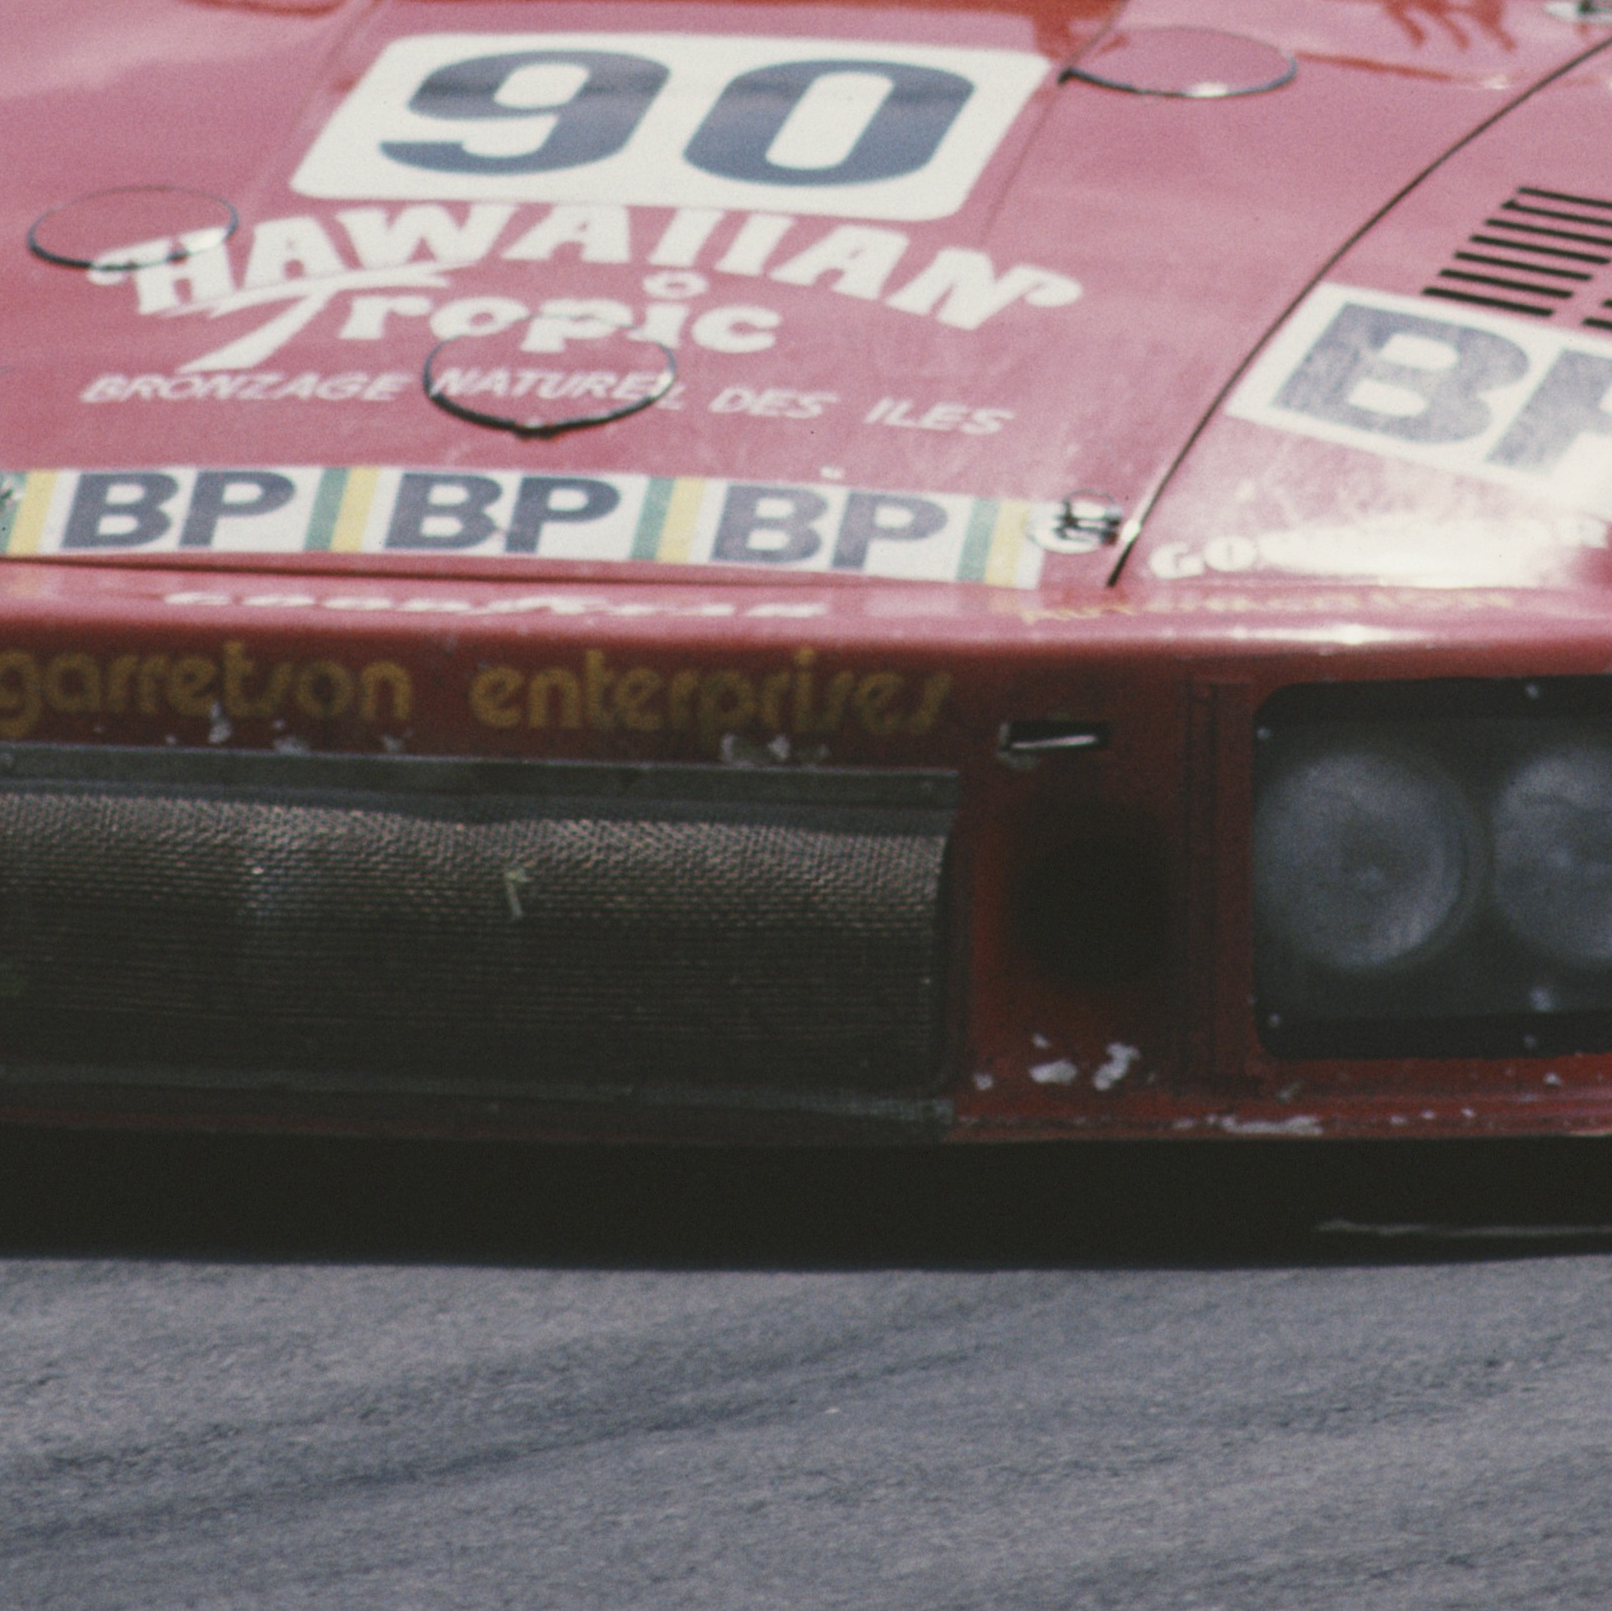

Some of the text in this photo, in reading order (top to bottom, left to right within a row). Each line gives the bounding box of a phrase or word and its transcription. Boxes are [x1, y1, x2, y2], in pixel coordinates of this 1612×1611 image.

[380, 49, 977, 187] 90
[87, 202, 1084, 330] HAWAIIAN
[81, 366, 1017, 436] BRONZAGE NATUREL DES ILES
[59, 470, 949, 571] BP BP BP
[468, 647, 954, 736] enterprises
